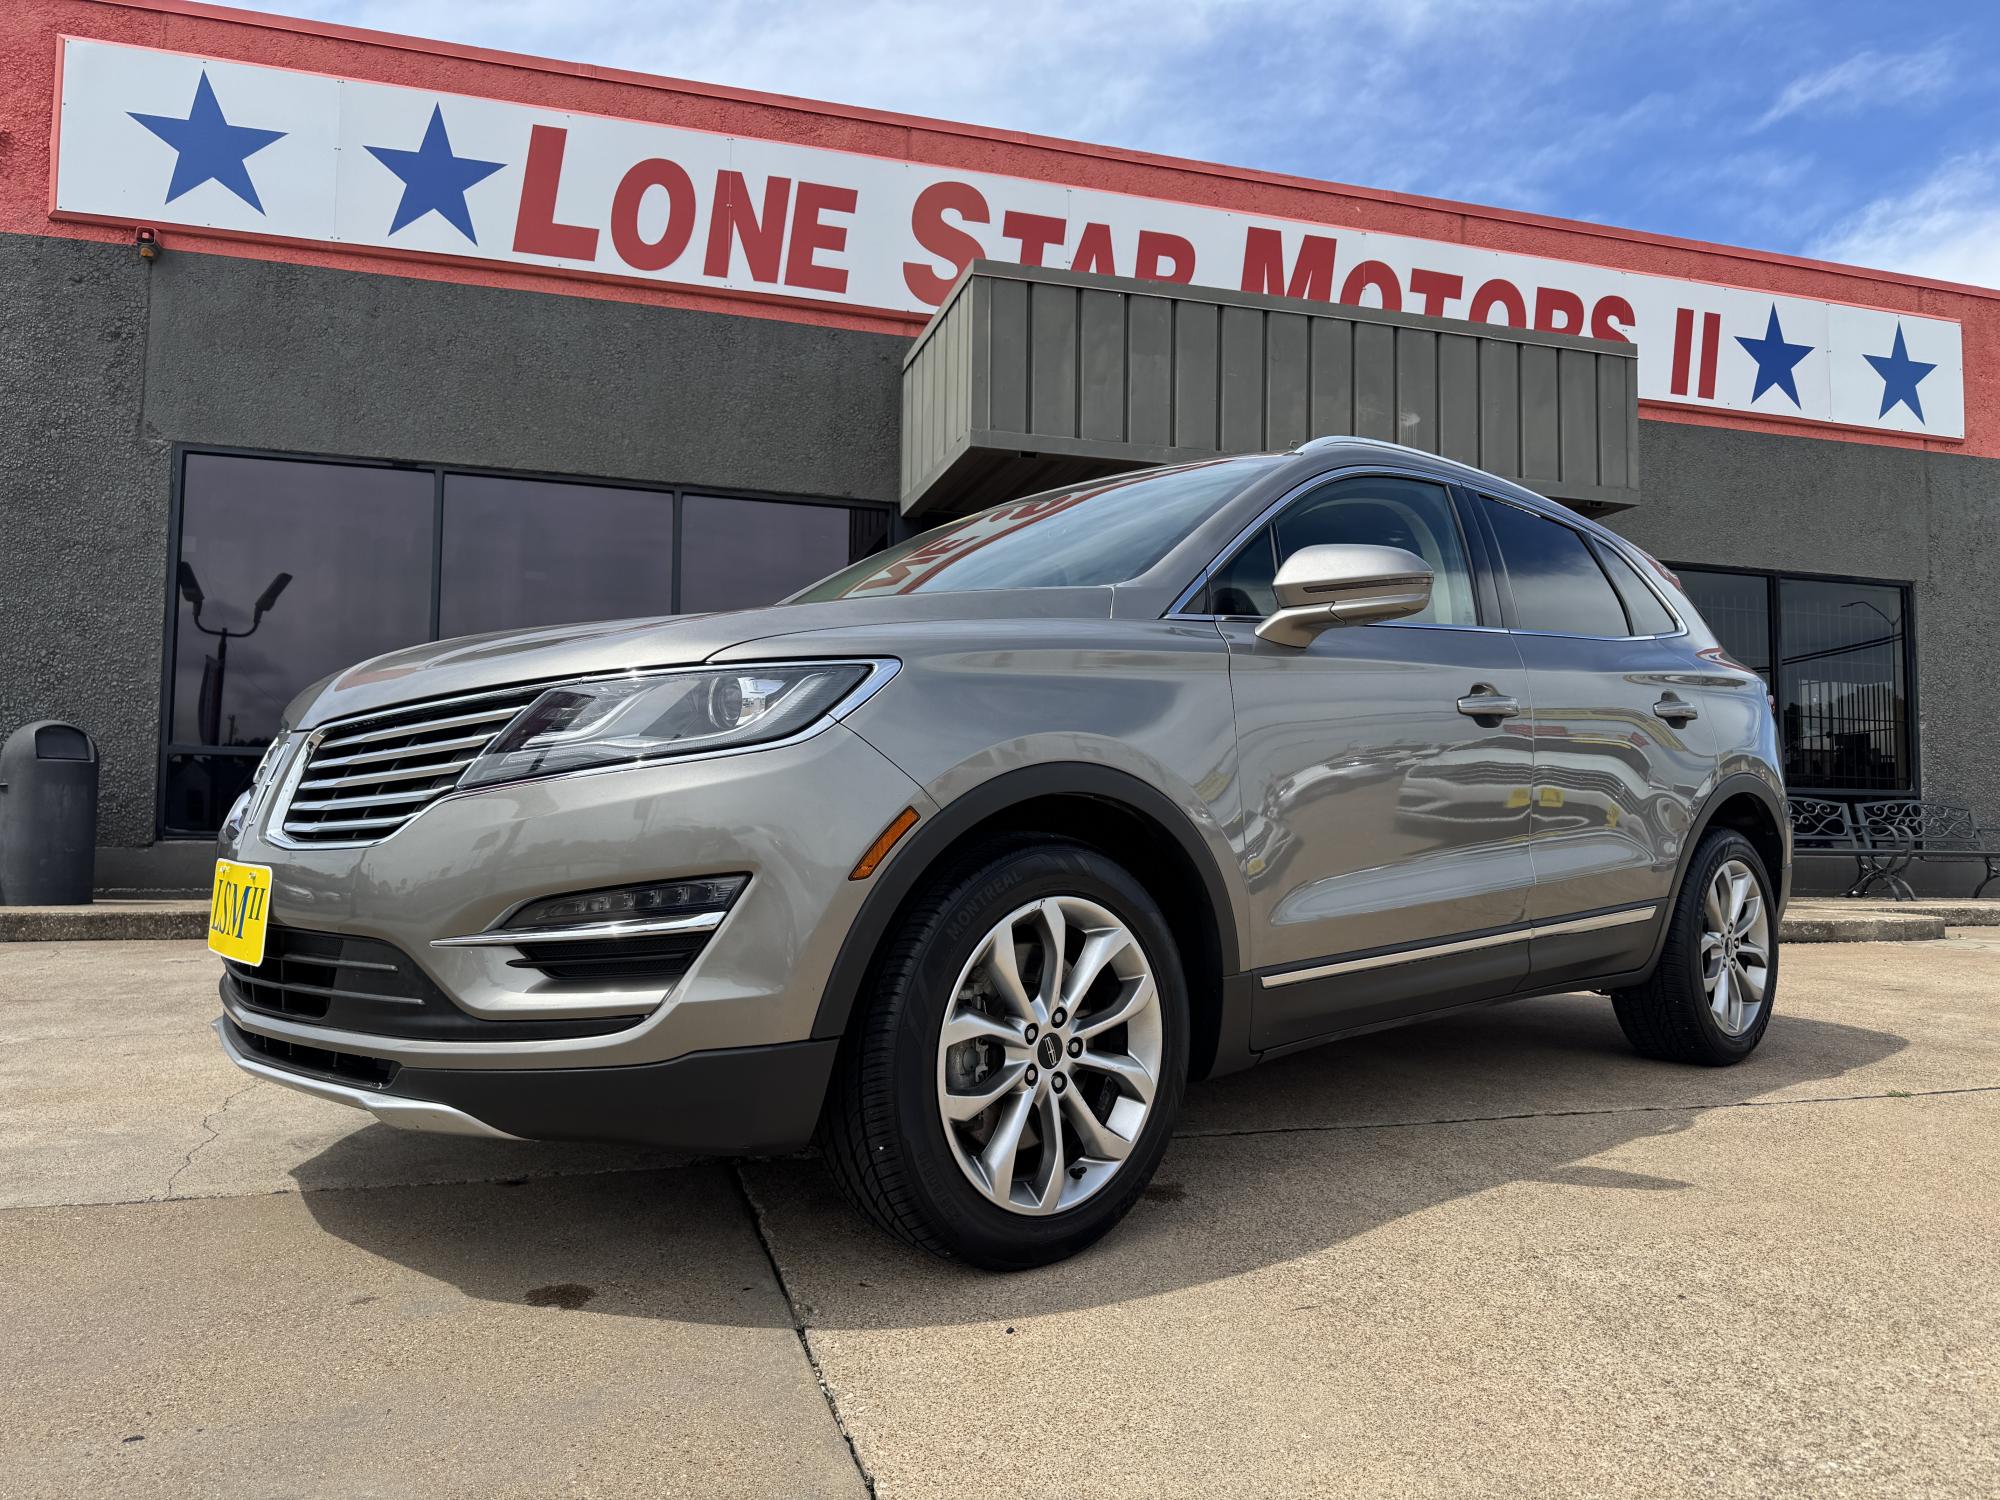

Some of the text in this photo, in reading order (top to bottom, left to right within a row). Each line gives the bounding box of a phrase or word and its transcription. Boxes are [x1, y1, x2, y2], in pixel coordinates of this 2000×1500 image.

[512, 124, 1721, 399] LONE STAR MOTORS II
[947, 870, 1024, 941] MONTREAL
